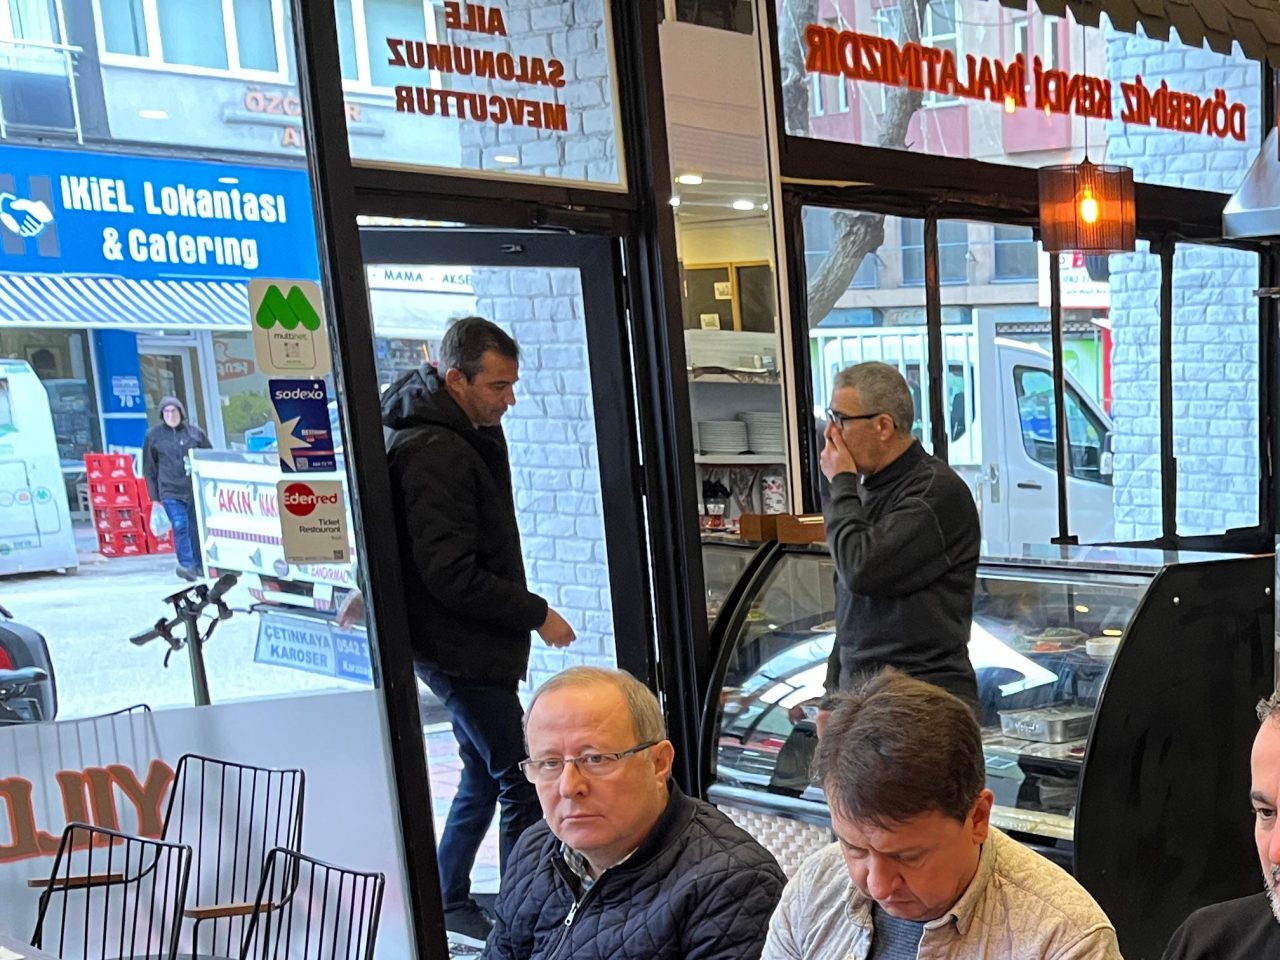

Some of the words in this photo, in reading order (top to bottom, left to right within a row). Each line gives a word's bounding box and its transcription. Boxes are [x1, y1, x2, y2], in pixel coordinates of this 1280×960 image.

[102, 226, 124, 262] &
[384, 269, 424, 283] MAMA
[273, 332, 307, 341] multinet
[275, 387, 324, 400] sodexo
[284, 492, 338, 505] Edenred
[318, 518, 340, 526] Ticket
[299, 525, 341, 534] Restaurant
[270, 643, 328, 668] KAROSER
